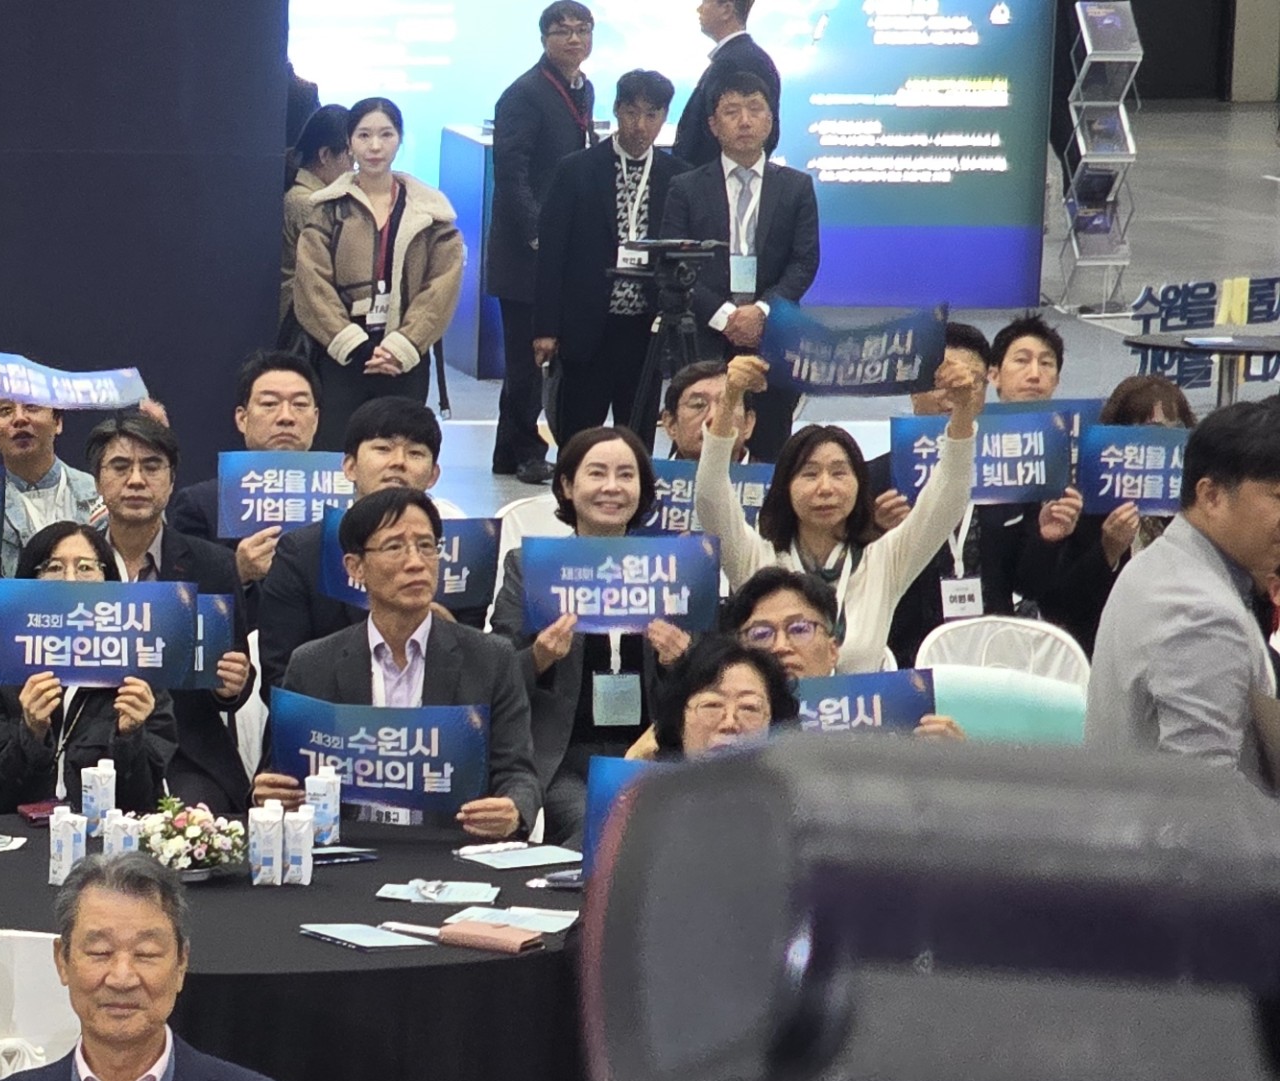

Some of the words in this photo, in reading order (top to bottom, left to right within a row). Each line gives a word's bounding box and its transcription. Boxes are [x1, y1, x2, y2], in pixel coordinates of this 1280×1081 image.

[1131, 282, 1217, 335] 수원을
[982, 432, 1044, 457] 새롭게
[1100, 445, 1166, 469] 수원을
[241, 470, 306, 494] 수원을
[311, 470, 355, 495] 새롭
[983, 459, 1046, 487] 빛나게
[1099, 472, 1165, 498] 기업을
[655, 479, 694, 503] 수원
[241, 498, 306, 522] 기업을
[444, 567, 470, 593] 날
[596, 555, 676, 584] 수원시
[551, 585, 655, 616] 기업인의
[27, 613, 63, 629] 제3회
[66, 602, 151, 631] 수원시
[15, 636, 129, 667] 기업인의
[136, 637, 165, 668] 날
[310, 730, 344, 747] 제3회
[348, 726, 438, 758] 수원시
[422, 763, 454, 793] 날
